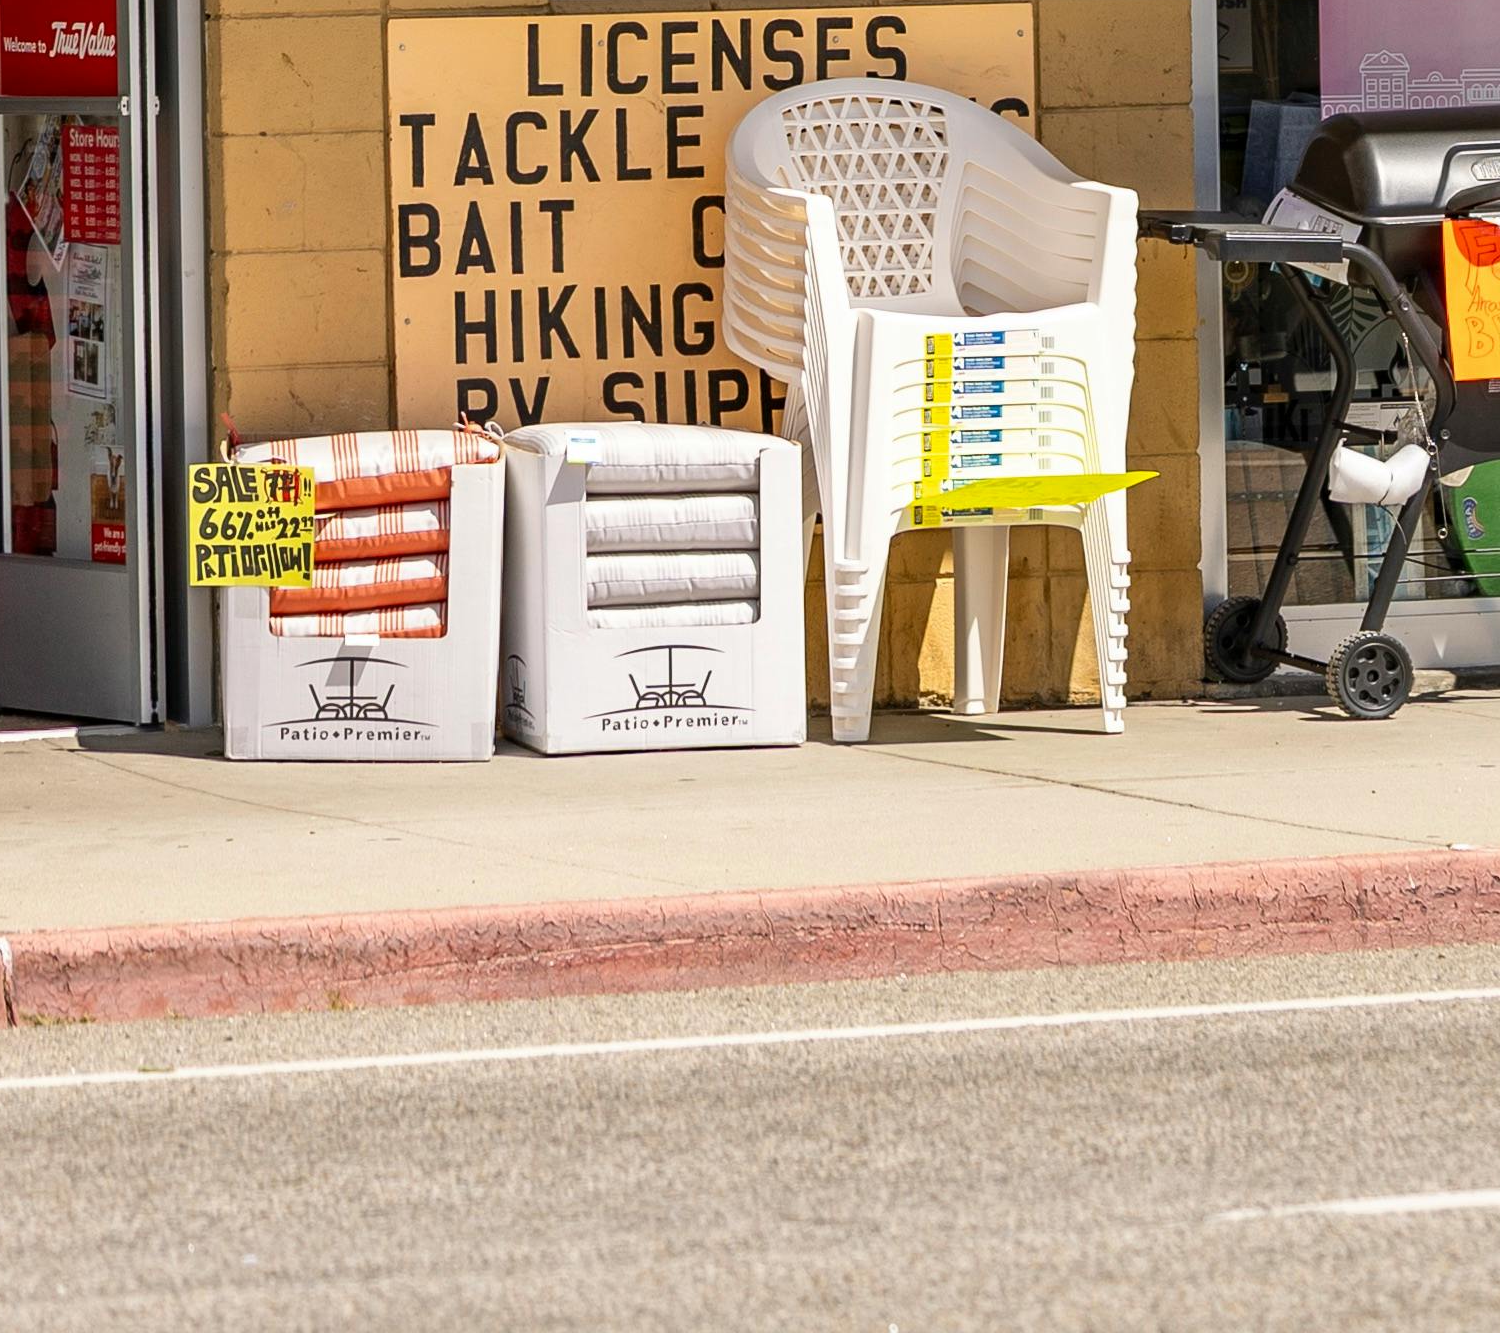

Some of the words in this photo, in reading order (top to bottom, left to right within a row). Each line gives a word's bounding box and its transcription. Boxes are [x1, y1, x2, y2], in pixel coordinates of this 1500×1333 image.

[3, 36, 37, 54] Welcome
[38, 39, 47, 54] to
[526, 14, 909, 98] LICENSES
[69, 129, 95, 148] Store
[399, 106, 706, 189] TACKLE
[398, 197, 576, 280] BAIT
[454, 281, 716, 366] HIKING
[192, 465, 259, 504] SALE
[198, 507, 255, 541] 66%
[279, 726, 330, 741] Patio
[343, 726, 422, 741] Premier
[601, 716, 650, 732] Patio
[663, 712, 740, 729] Premier
